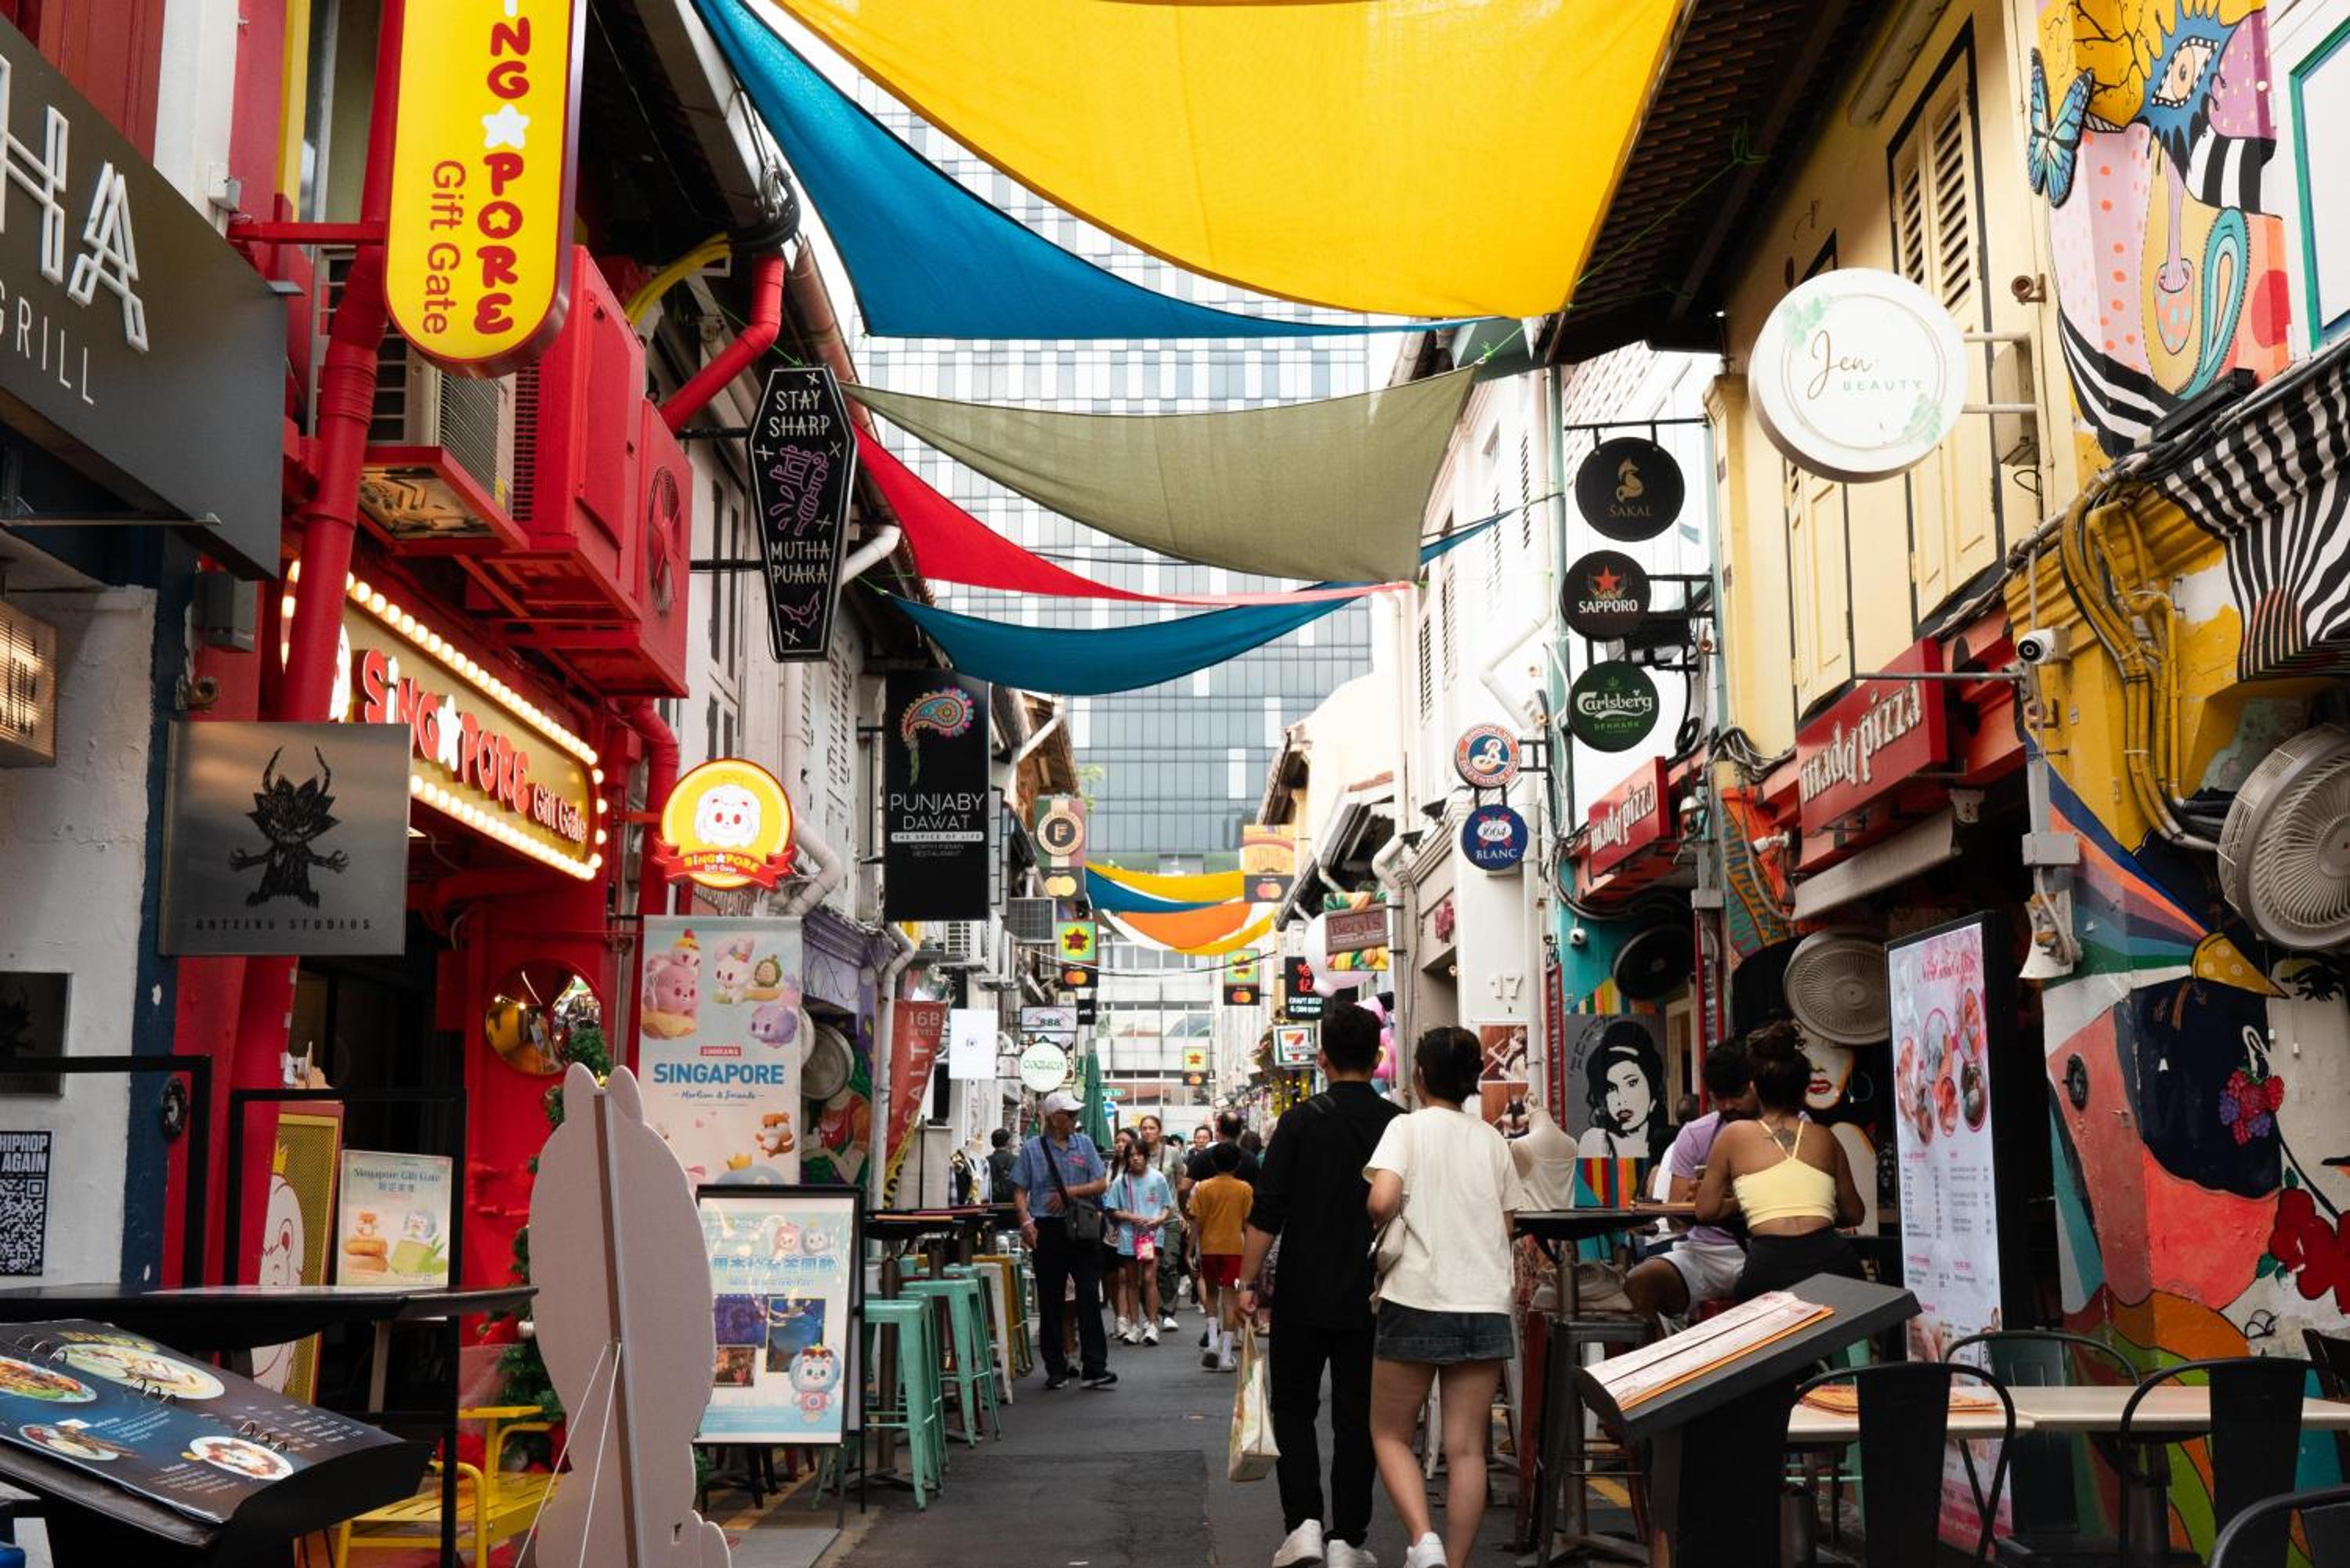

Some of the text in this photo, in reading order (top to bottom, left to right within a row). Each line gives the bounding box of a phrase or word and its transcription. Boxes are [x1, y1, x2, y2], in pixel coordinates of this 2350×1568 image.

[422, 160, 467, 334] Gift Gate
[1808, 330, 1873, 400] Jen
[1843, 379, 1921, 391] BEAUTY
[776, 389, 821, 412] STAY
[768, 415, 830, 438] SHARP
[770, 541, 830, 561] MUTHA
[772, 565, 828, 584] PUAKA
[1578, 599, 1638, 613] SAPPORO
[1577, 690, 1653, 719] Carlsberg
[890, 793, 985, 815] PUNJABY
[903, 815, 971, 829] DAWAT
[1054, 824, 1067, 841] F
[1476, 849, 1517, 860] BLANC
[289, 919, 370, 930] STUDIOS
[1489, 973, 1524, 999] 17
[1040, 1017, 1062, 1028] 888
[653, 1063, 785, 1085] SINGAPORE
[0, 1134, 48, 1152] HIPHOP
[2, 1152, 46, 1172] AGAIN
